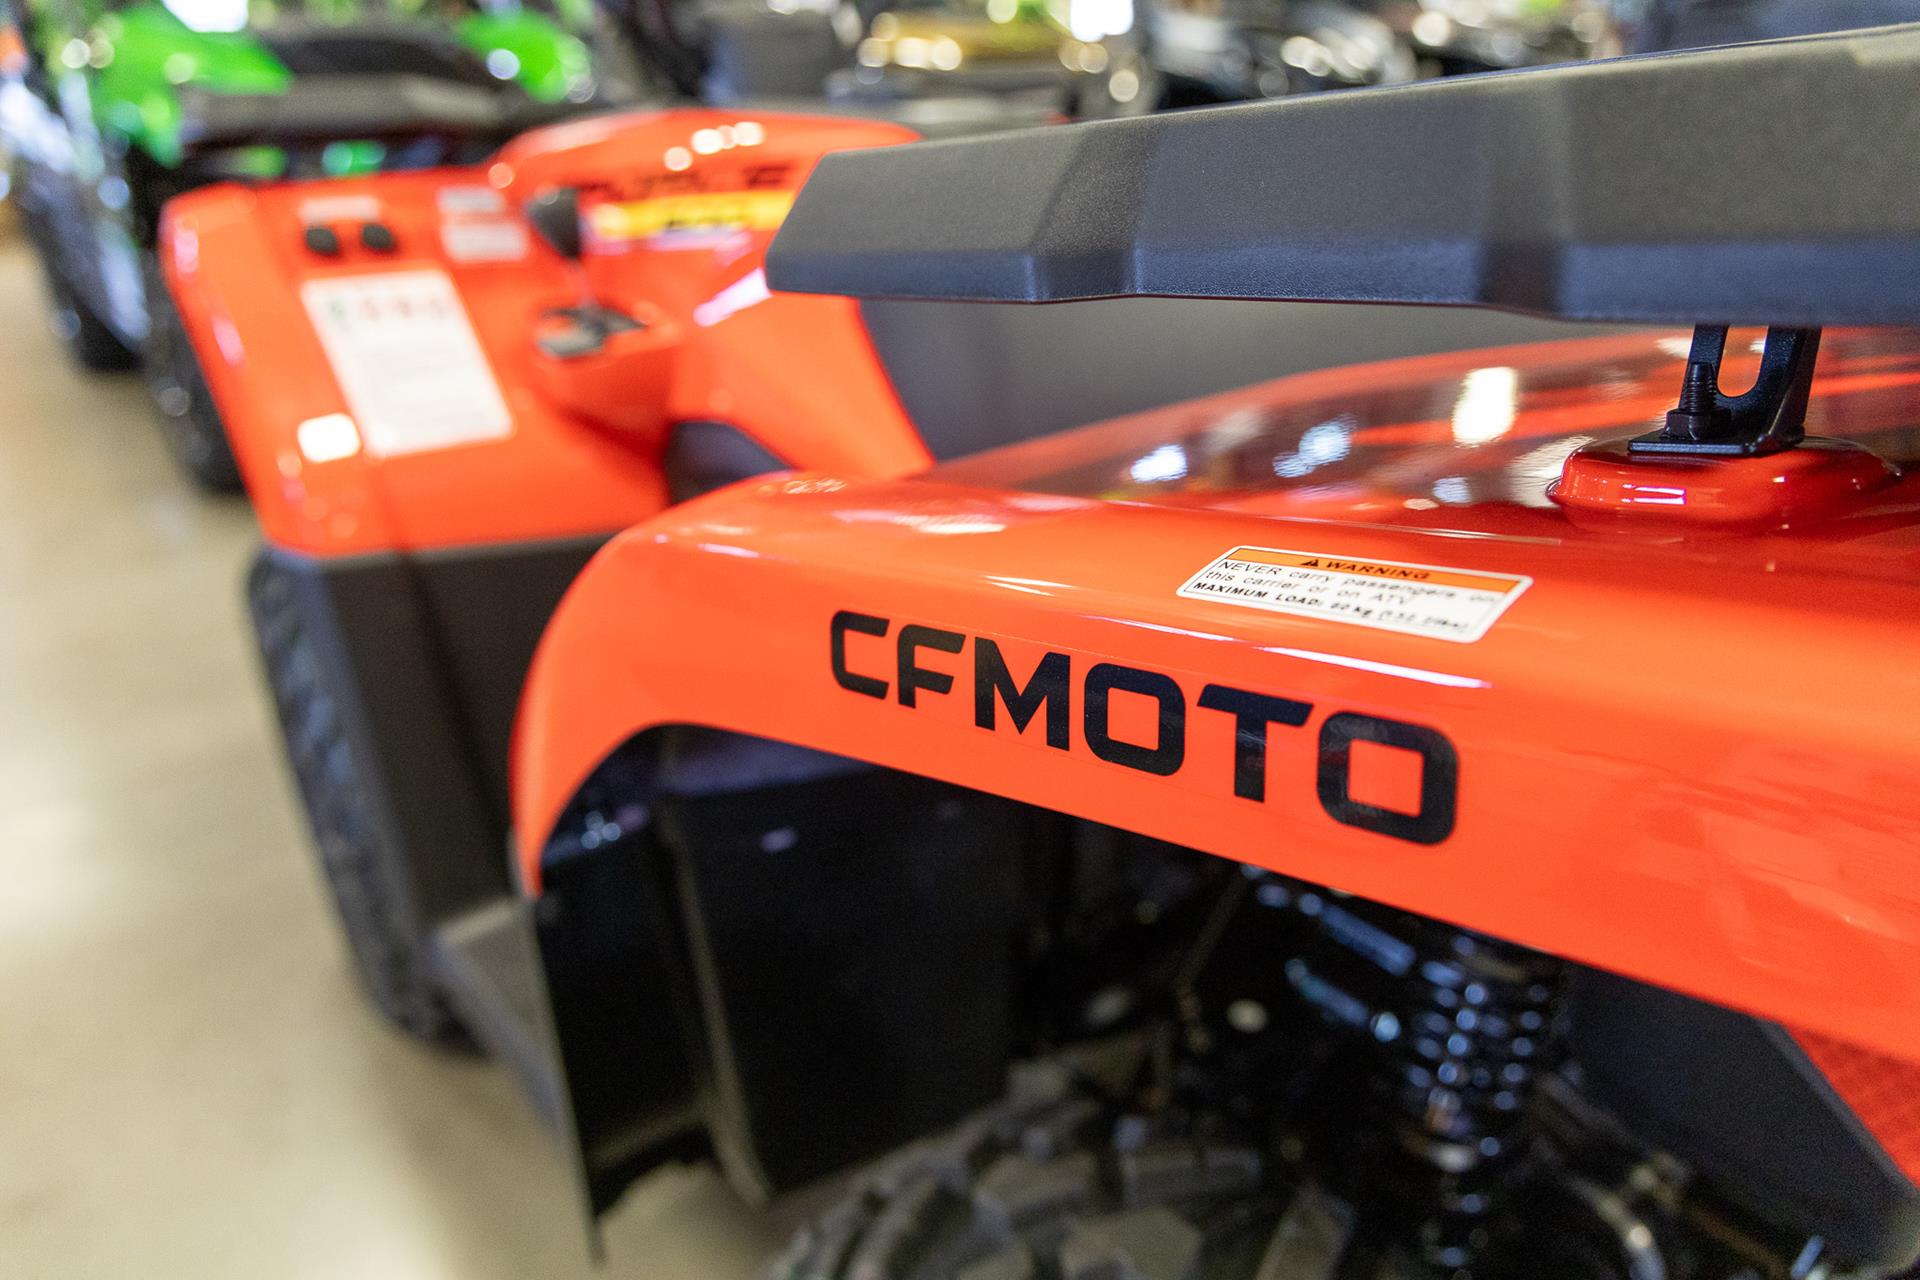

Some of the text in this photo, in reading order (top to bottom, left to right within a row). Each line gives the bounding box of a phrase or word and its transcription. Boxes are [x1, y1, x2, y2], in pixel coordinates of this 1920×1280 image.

[1218, 561, 1282, 576] NEVER
[1289, 569, 1335, 583] carry
[1326, 561, 1430, 580] WARNING
[1193, 582, 1269, 598] MAXIMUM
[1205, 571, 1236, 582] this
[1243, 576, 1301, 590] carrier
[1308, 585, 1329, 594] or
[830, 609, 1460, 846] CFMOTO
